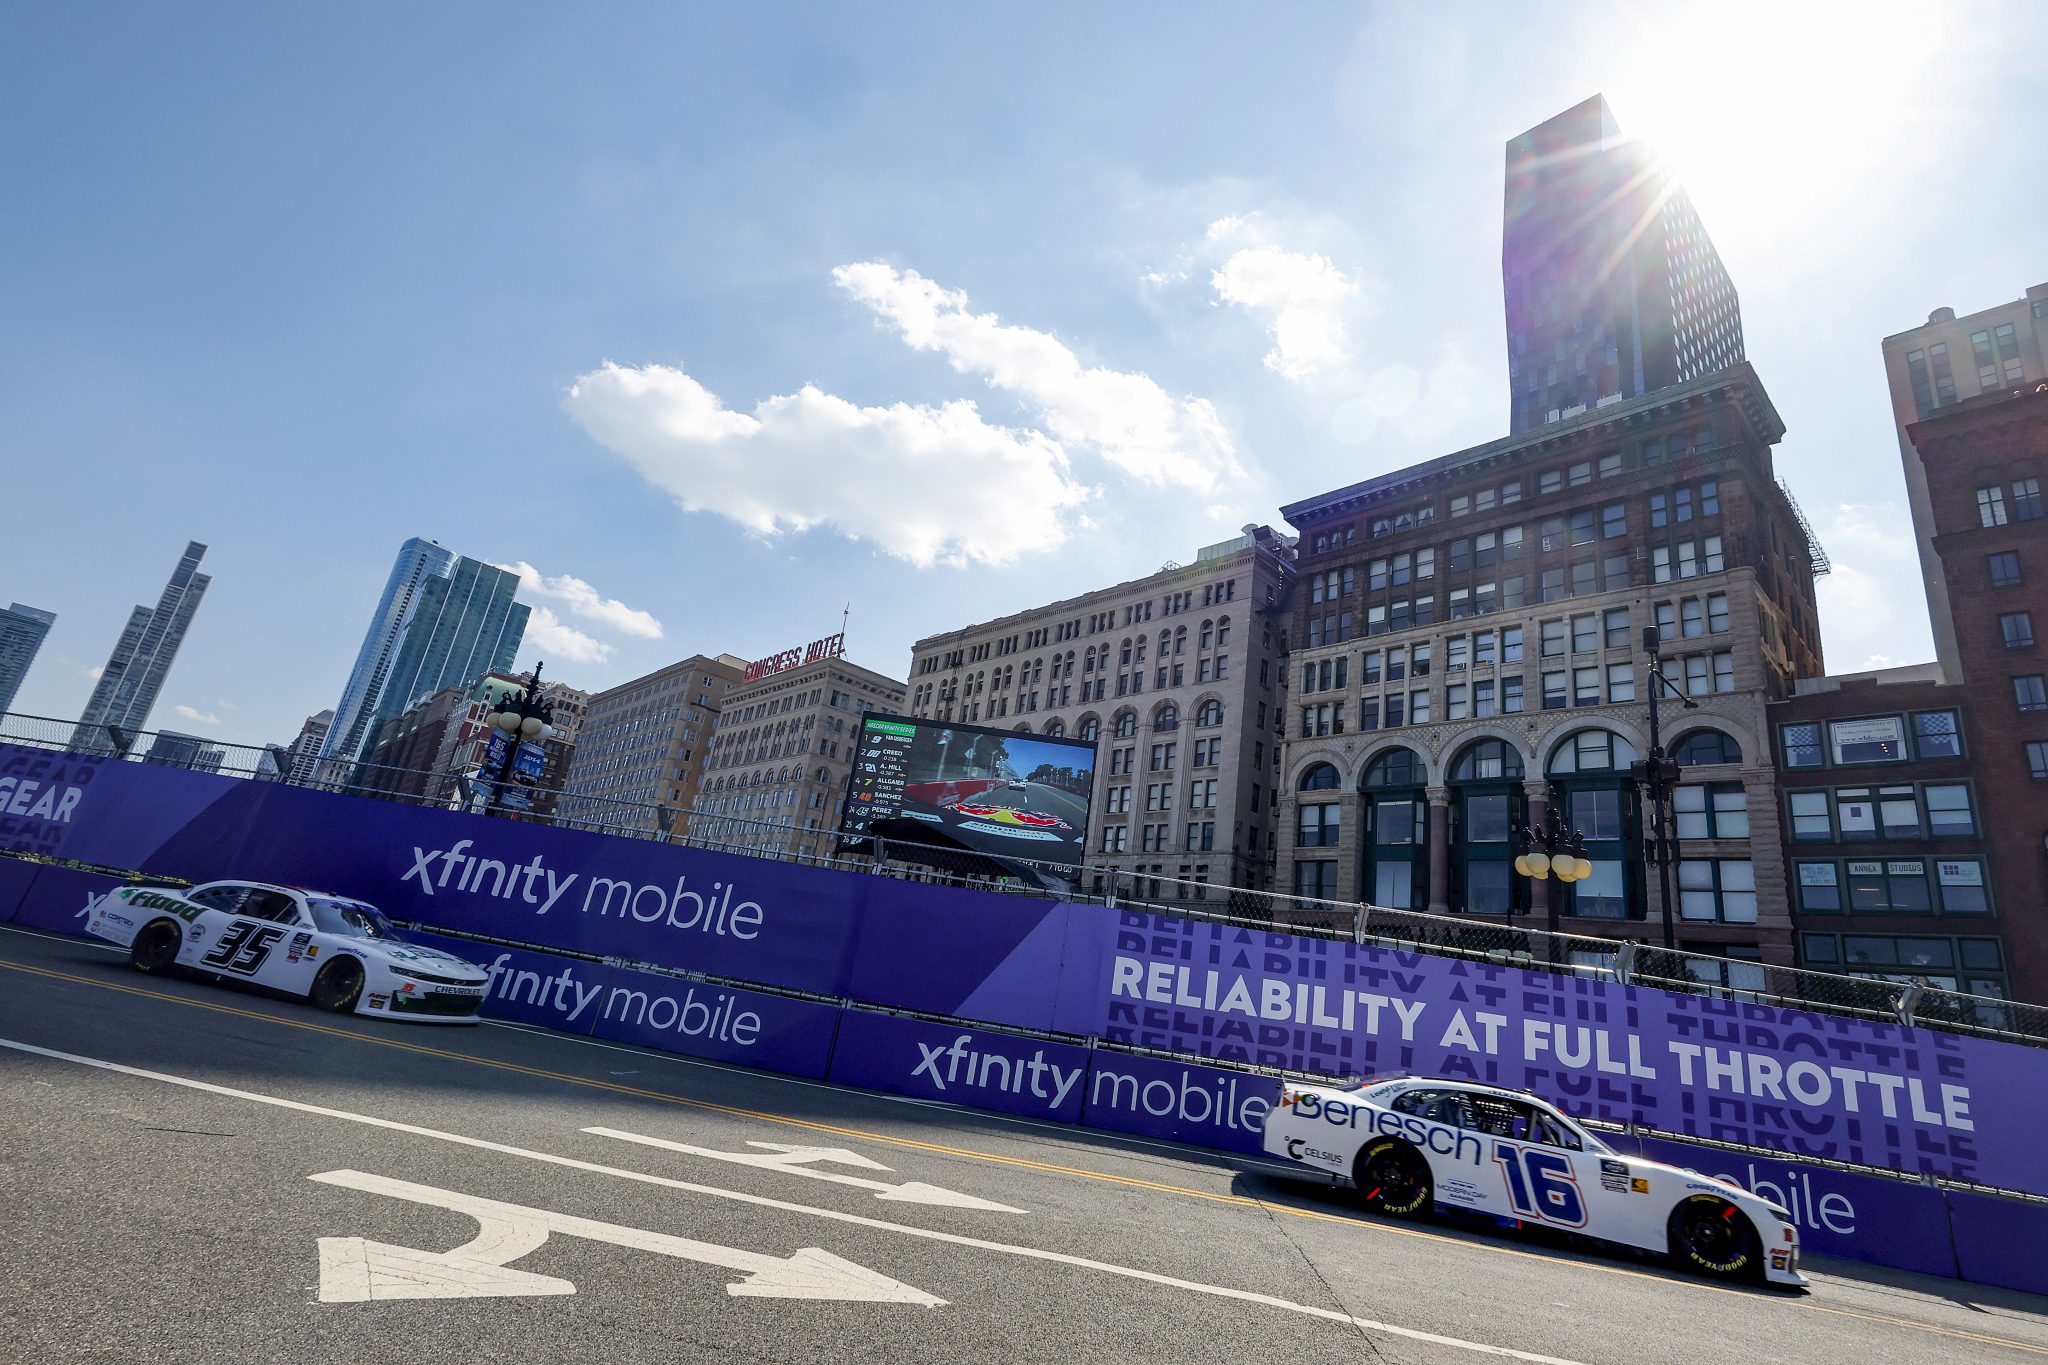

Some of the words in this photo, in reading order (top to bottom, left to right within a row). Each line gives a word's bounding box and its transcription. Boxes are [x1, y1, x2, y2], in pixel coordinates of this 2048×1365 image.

[744, 646, 802, 681] CONGRESS
[804, 632, 846, 665] HOTEL
[871, 735, 882, 744] 9
[864, 778, 873, 786] 7
[877, 778, 904, 786] ALLGAIER
[865, 763, 877, 773] 21
[0, 776, 82, 823] GEAR
[852, 791, 858, 799] 5
[874, 791, 902, 800] SANCHEZ
[855, 822, 864, 830] 4
[400, 839, 579, 915] xfinity
[582, 875, 764, 940] mobile
[1854, 865, 1877, 873] ANNEX
[1889, 864, 1922, 873] STUDIOS
[200, 918, 290, 976] 35
[434, 985, 481, 996] CHEVROLET
[479, 954, 603, 1021] finity
[603, 986, 762, 1046] mobile
[1111, 955, 1427, 1041] RELIABILITY
[1439, 1008, 1507, 1055] AT
[1523, 1018, 1656, 1080] FULL
[1668, 1040, 1974, 1132] THROTTLE
[911, 1035, 1082, 1109] xfinity
[1092, 1070, 1270, 1133] mobile
[1292, 1091, 1482, 1166] Benesch
[1304, 1147, 1343, 1164] CELSIUS
[1491, 1138, 1589, 1229] 16
